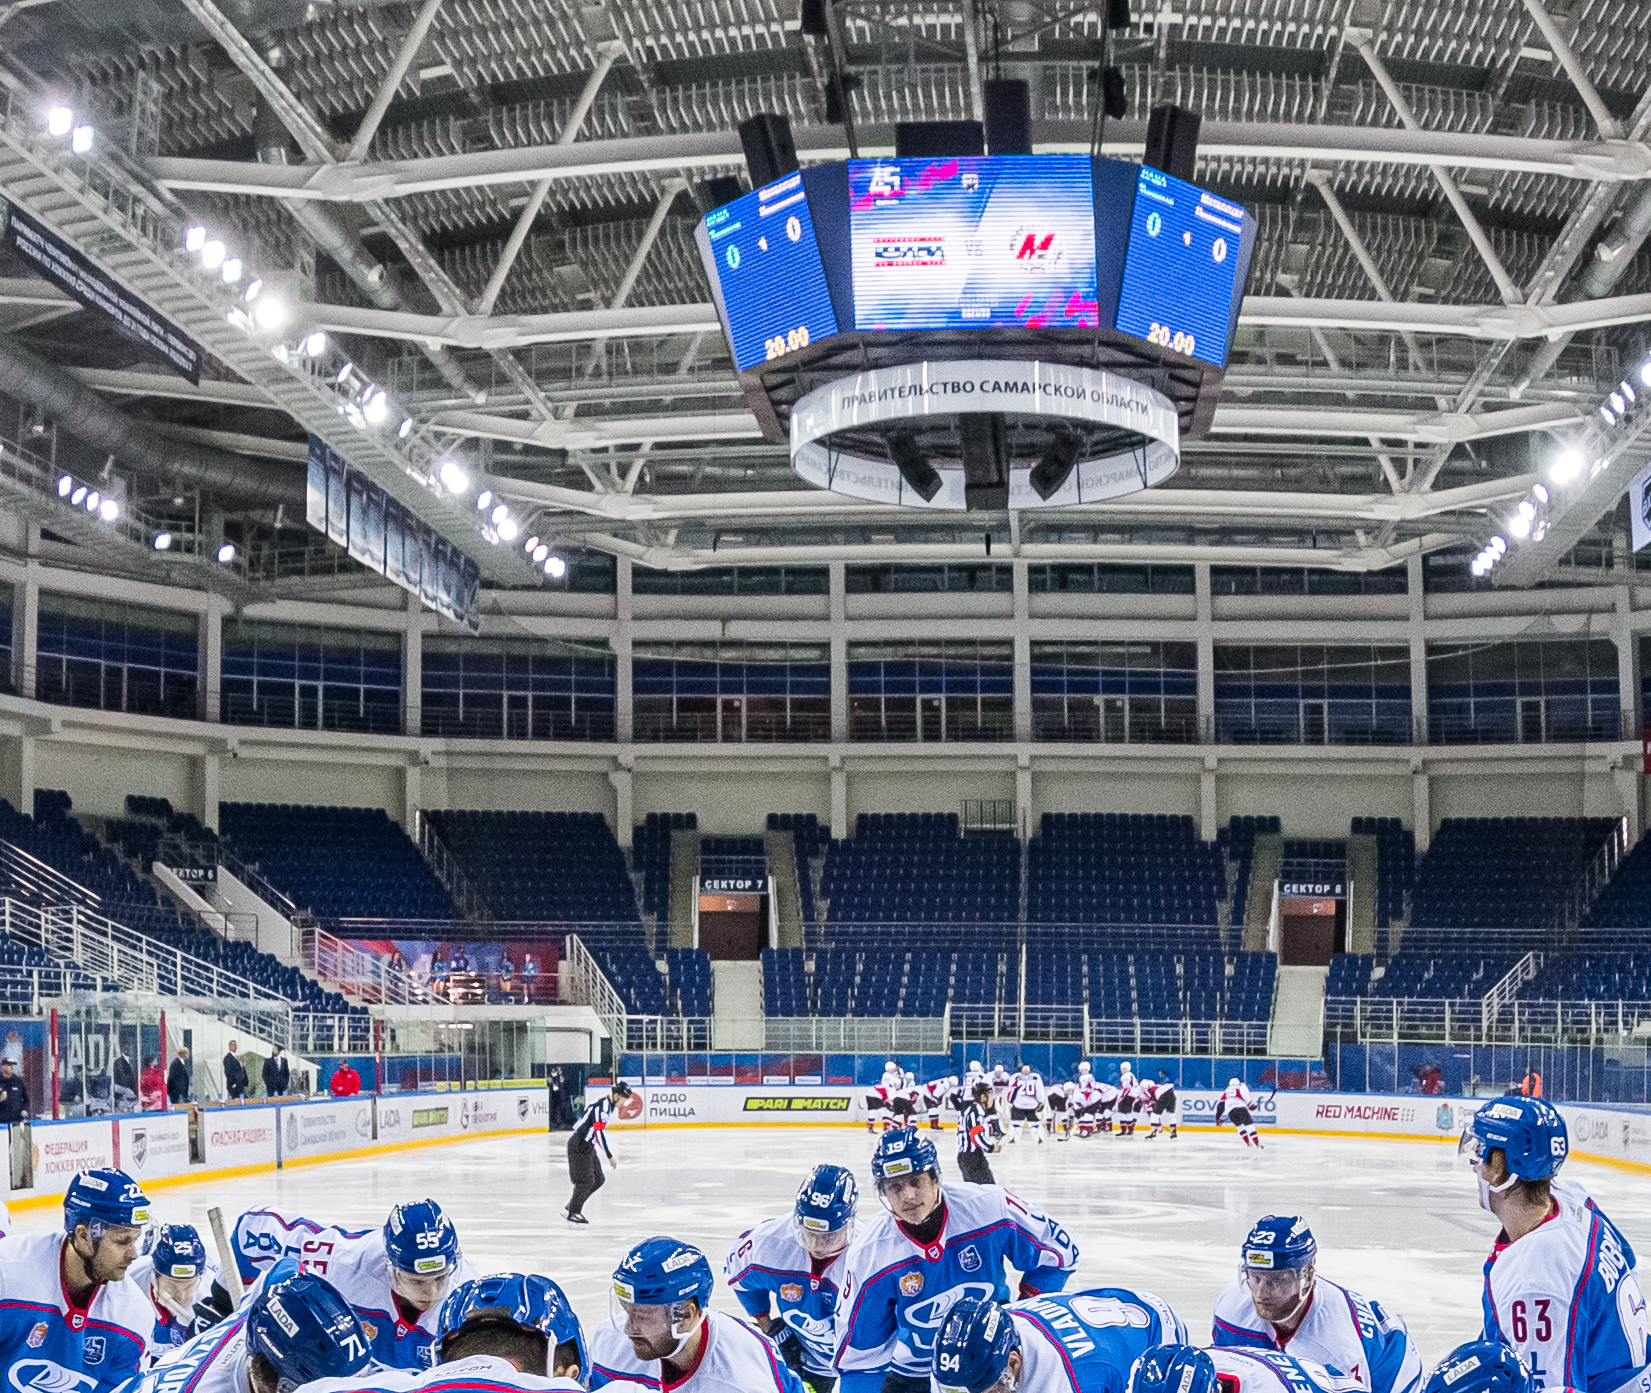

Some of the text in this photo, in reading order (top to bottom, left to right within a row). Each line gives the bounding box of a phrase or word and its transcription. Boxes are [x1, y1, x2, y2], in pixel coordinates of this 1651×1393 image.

[841, 379, 1149, 415] ПРАВИТЕЛЬСТВО САМАРСКОЙ ОБЛАСТИ
[705, 880, 763, 889] СЕКТОР 7
[1284, 883, 1330, 893] СЕКТОР
[1017, 1081, 1035, 1095] 20
[650, 1093, 687, 1104] ДОДО
[747, 1099, 848, 1110] PARI MATCH
[650, 1106, 696, 1118] ПИЦЦА
[1316, 1104, 1399, 1121] RED MACHINE
[44, 1140, 88, 1156] ФЕДЕРАЦИЯ
[886, 1141, 906, 1154] 19
[1551, 1137, 1565, 1155] 63
[45, 1155, 106, 1174] ХОККЕЯ РОССИИ
[810, 1192, 830, 1208] 96
[416, 1232, 441, 1250] 55
[1252, 1231, 1276, 1244] 23
[174, 1242, 192, 1256] 25
[666, 1255, 695, 1273] LADA
[269, 1302, 296, 1334] LADA
[1511, 1299, 1553, 1343] 63
[220, 1338, 245, 1366] LUTCH
[338, 1332, 367, 1362] 71
[939, 1352, 960, 1373] 94
[1447, 1359, 1477, 1382] LADA
